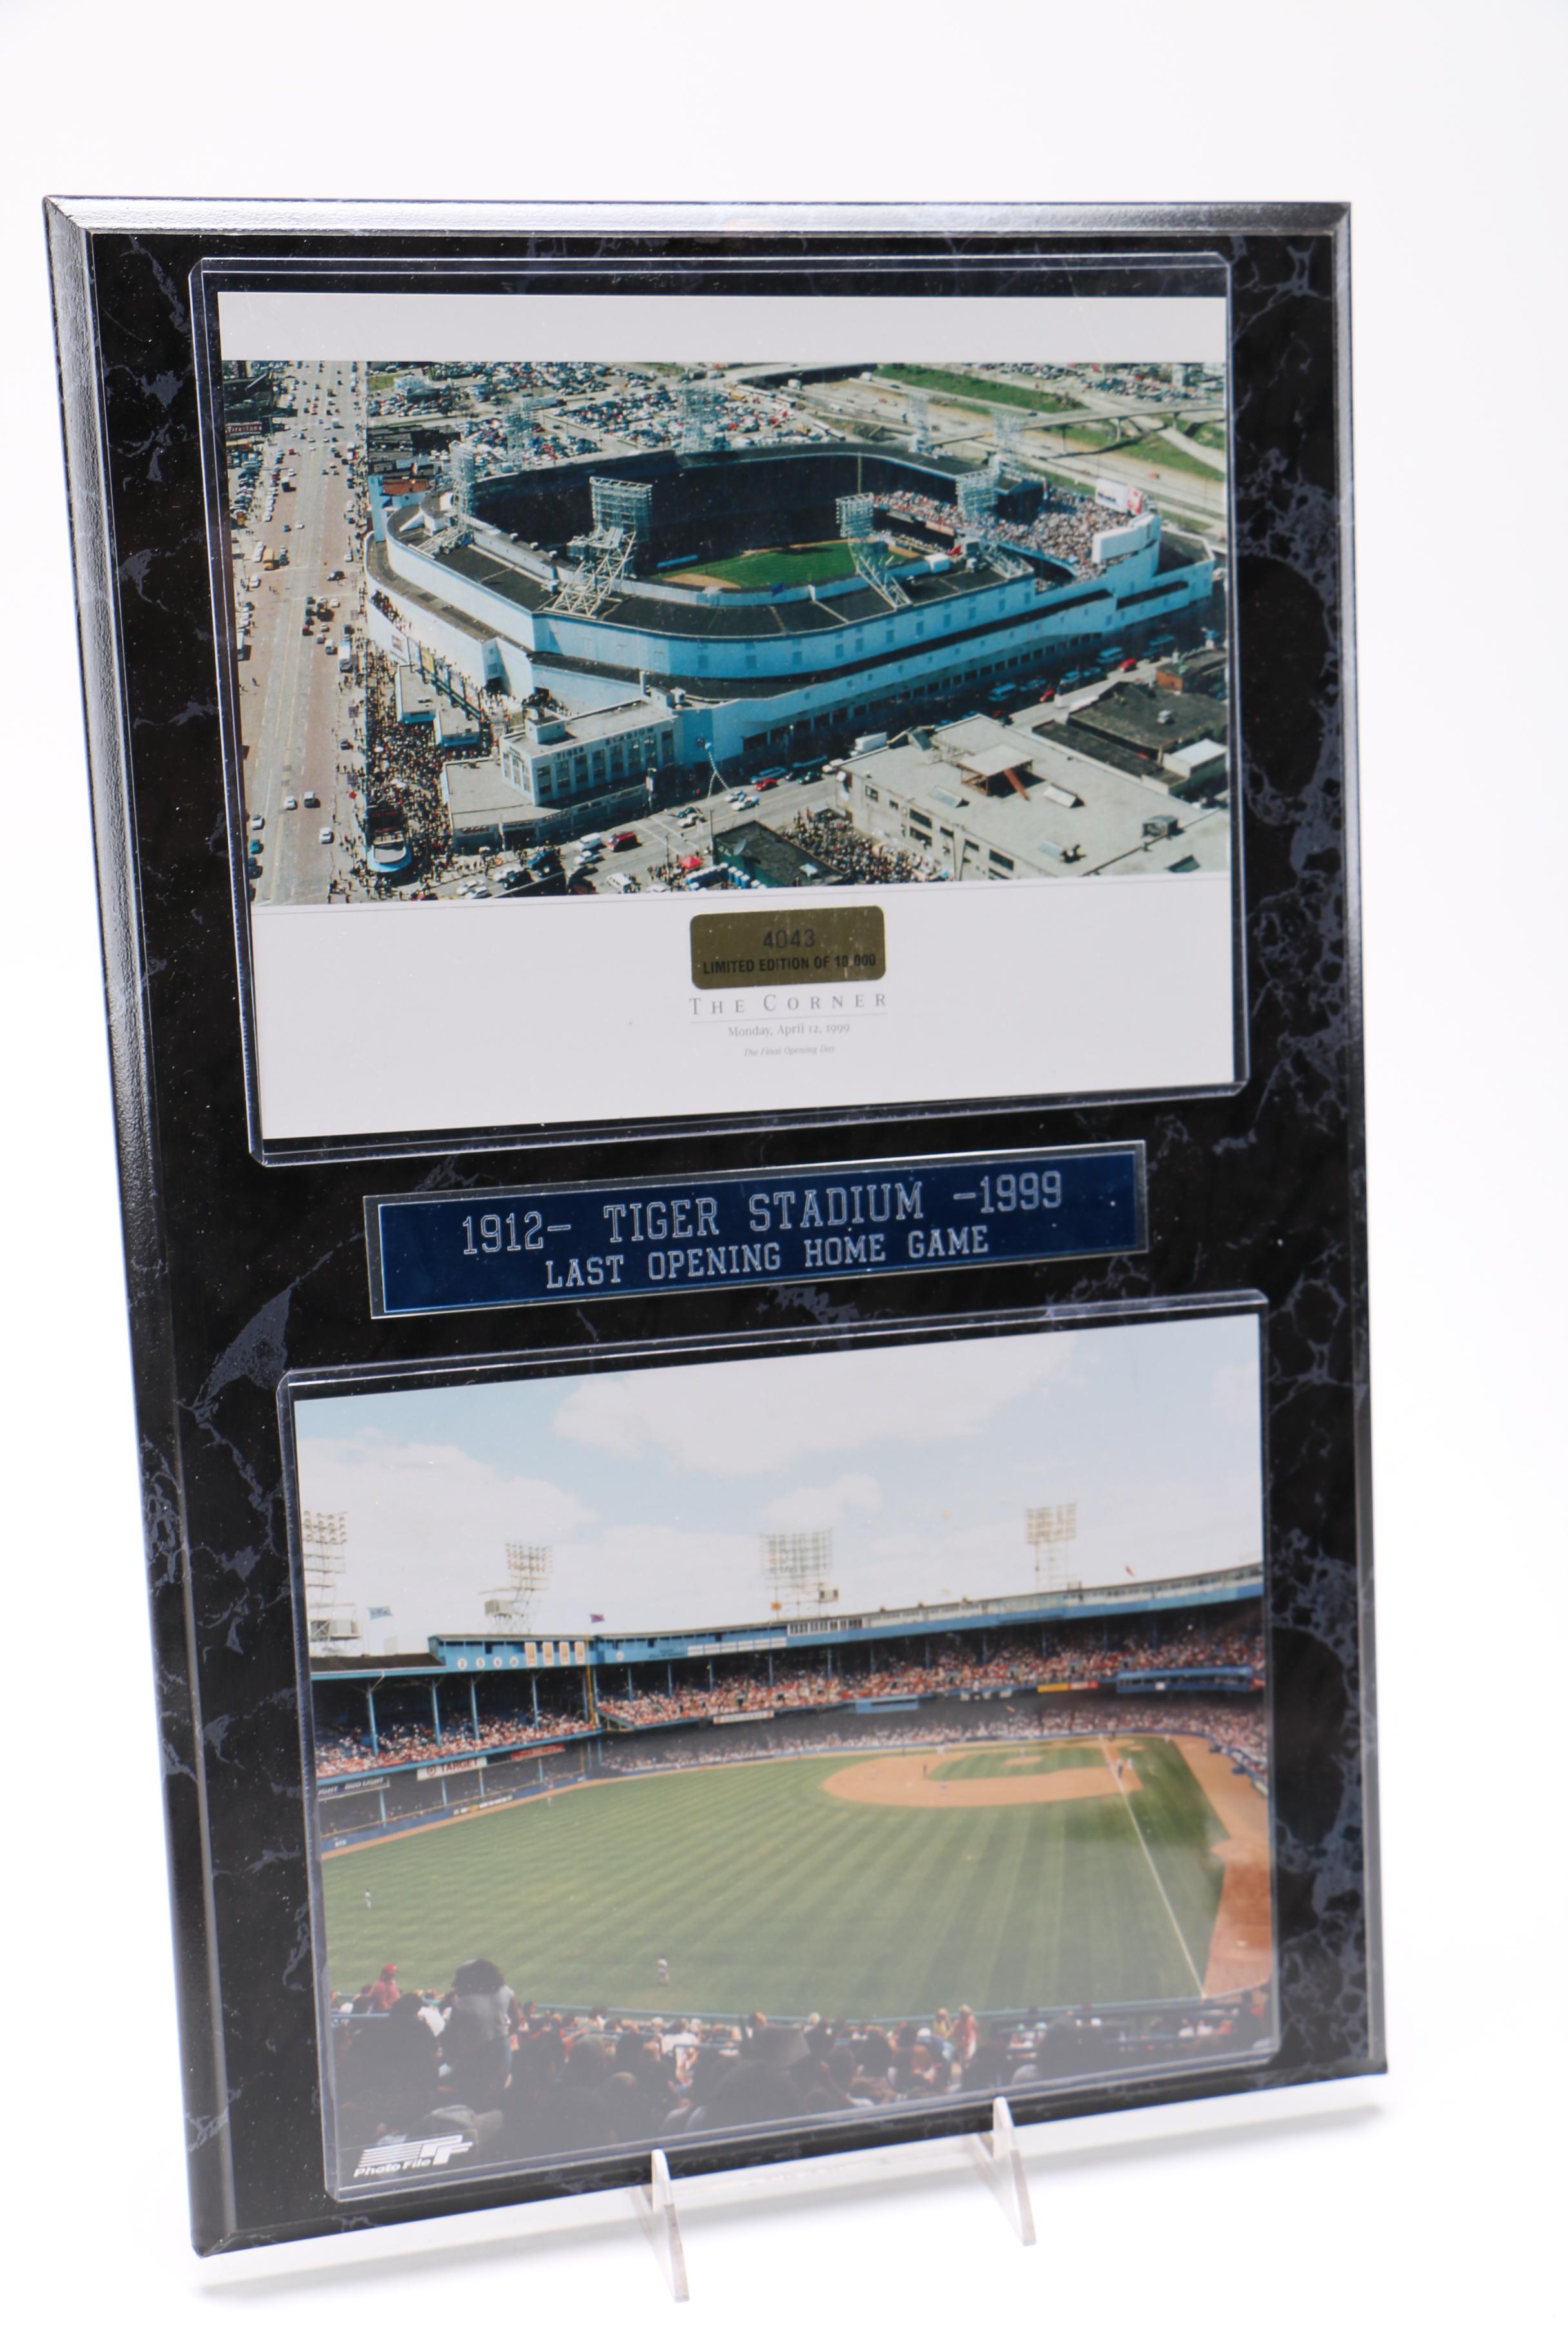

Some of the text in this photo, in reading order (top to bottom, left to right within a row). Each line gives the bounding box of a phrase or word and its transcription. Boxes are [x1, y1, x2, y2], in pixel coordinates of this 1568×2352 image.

[763, 928, 816, 948] 4043
[703, 959, 754, 974] LIMITED
[759, 957, 809, 972] EDITION
[814, 956, 830, 968] OF
[689, 992, 887, 1015] THE CORNER
[728, 1023, 850, 1038] Monday, April 12, 1999
[745, 1044, 836, 1057] The Final Opening Day
[461, 1170, 1063, 1255] 1912- TIGER STADIUM -1999
[545, 1225, 989, 1289] LAST OPENING HOME GAME
[441, 1758, 478, 1772] TARGET
[353, 2158, 432, 2178] Photo File
